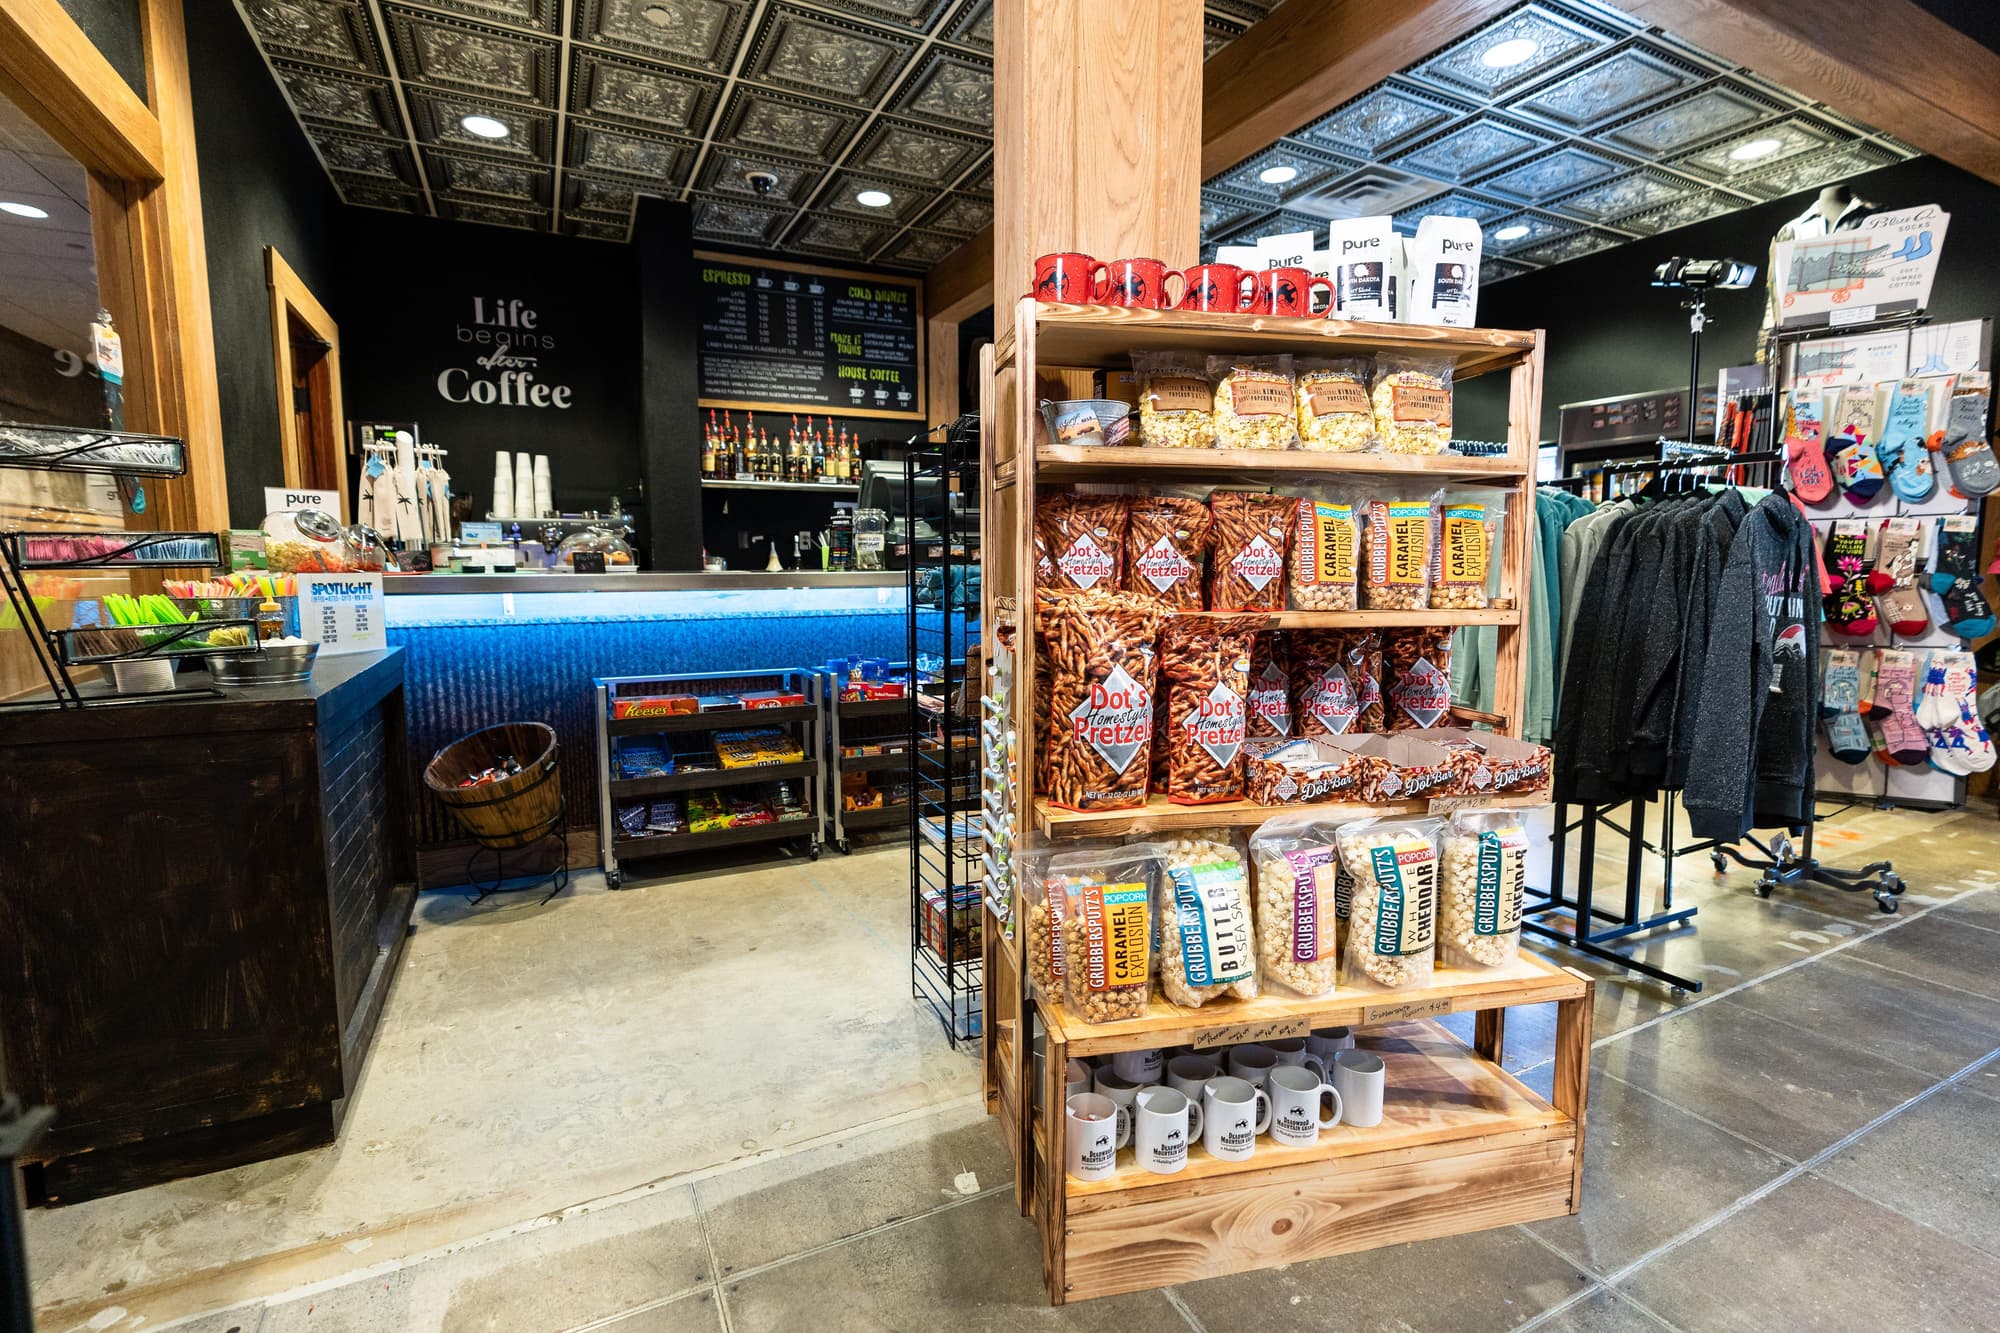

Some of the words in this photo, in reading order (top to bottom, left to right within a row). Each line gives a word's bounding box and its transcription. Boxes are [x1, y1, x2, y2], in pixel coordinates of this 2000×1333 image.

[1869, 216, 1911, 230] Blue
[1898, 222, 1930, 232] SOCKS
[1343, 238, 1380, 255] pure
[1442, 238, 1473, 254] pure
[1269, 255, 1303, 270] pure
[703, 268, 751, 285] ESPRESSO
[849, 286, 872, 300] COLD
[874, 287, 908, 304] DRINKS
[473, 296, 537, 329] Life
[456, 324, 555, 350] begins
[830, 332, 852, 346] MAKE
[853, 334, 862, 346] IT
[476, 345, 537, 370] after
[837, 342, 862, 357] YOURS
[838, 365, 868, 381] HOUSE
[869, 368, 900, 383] COFFEE
[437, 367, 573, 408] Coffee
[286, 493, 321, 508] pure
[1316, 508, 1351, 518] POPCORN
[1389, 509, 1430, 517] POPCORN
[1446, 510, 1484, 519] POPCORN
[1300, 498, 1315, 583] GRUBBERSPUTZ'S
[1324, 519, 1337, 577] CARAMEL
[1370, 502, 1386, 584] GRUBBERSPUTZ'S
[1395, 519, 1409, 578] CARAMEL
[1452, 521, 1462, 577] CARAMEL
[1068, 544, 1101, 558] Dot's
[1146, 545, 1179, 560] Dot's
[1241, 556, 1275, 566] Homestyle
[1242, 544, 1274, 558] Dot's
[1060, 563, 1110, 577] Pretzels
[1138, 563, 1190, 577] Pretzels
[1233, 563, 1281, 577] Pretzels
[311, 582, 373, 595] SPOTLIGHT
[1254, 674, 1284, 693] Dot'
[1314, 675, 1351, 696] Dot's
[1401, 671, 1444, 686] Dot's
[1090, 683, 1147, 710] Dot's
[1258, 692, 1287, 703] Homes
[1399, 684, 1446, 698] Homestyle
[1199, 695, 1243, 717] Dot's
[1250, 700, 1290, 719] Pretz
[1391, 692, 1451, 711] Pretzels
[1086, 706, 1148, 729] Homestyle
[1073, 716, 1153, 746] Pretzels
[1404, 774, 1432, 796] Dot
[1432, 769, 1454, 784] Bar
[1494, 770, 1521, 790] Dot
[1520, 764, 1542, 777] Bar
[1301, 781, 1330, 801] Dot
[1330, 774, 1353, 789] Bar
[1398, 849, 1435, 864] POPCORN
[1478, 833, 1499, 933] GRUBBERSPUTZ'S
[1503, 851, 1514, 924] WHITE
[1512, 848, 1528, 922] CHEDDAR
[1104, 893, 1147, 904] POPCORN
[1289, 853, 1314, 960] GRUBBERSPUTZ'S
[1374, 849, 1401, 953] GRUBBERSPUTZ'S
[1406, 867, 1417, 945] WHITE
[1417, 863, 1433, 942] CHEDDAR
[1172, 869, 1208, 982] GRUBBERSPUTZ'S
[1207, 887, 1239, 972] BUTTER
[1084, 889, 1102, 988] GRUBBERSPUTZ'S
[1113, 907, 1128, 978] CARAMEL
[1128, 905, 1144, 978] EXPLOSION
[1234, 924, 1248, 953] SEA
